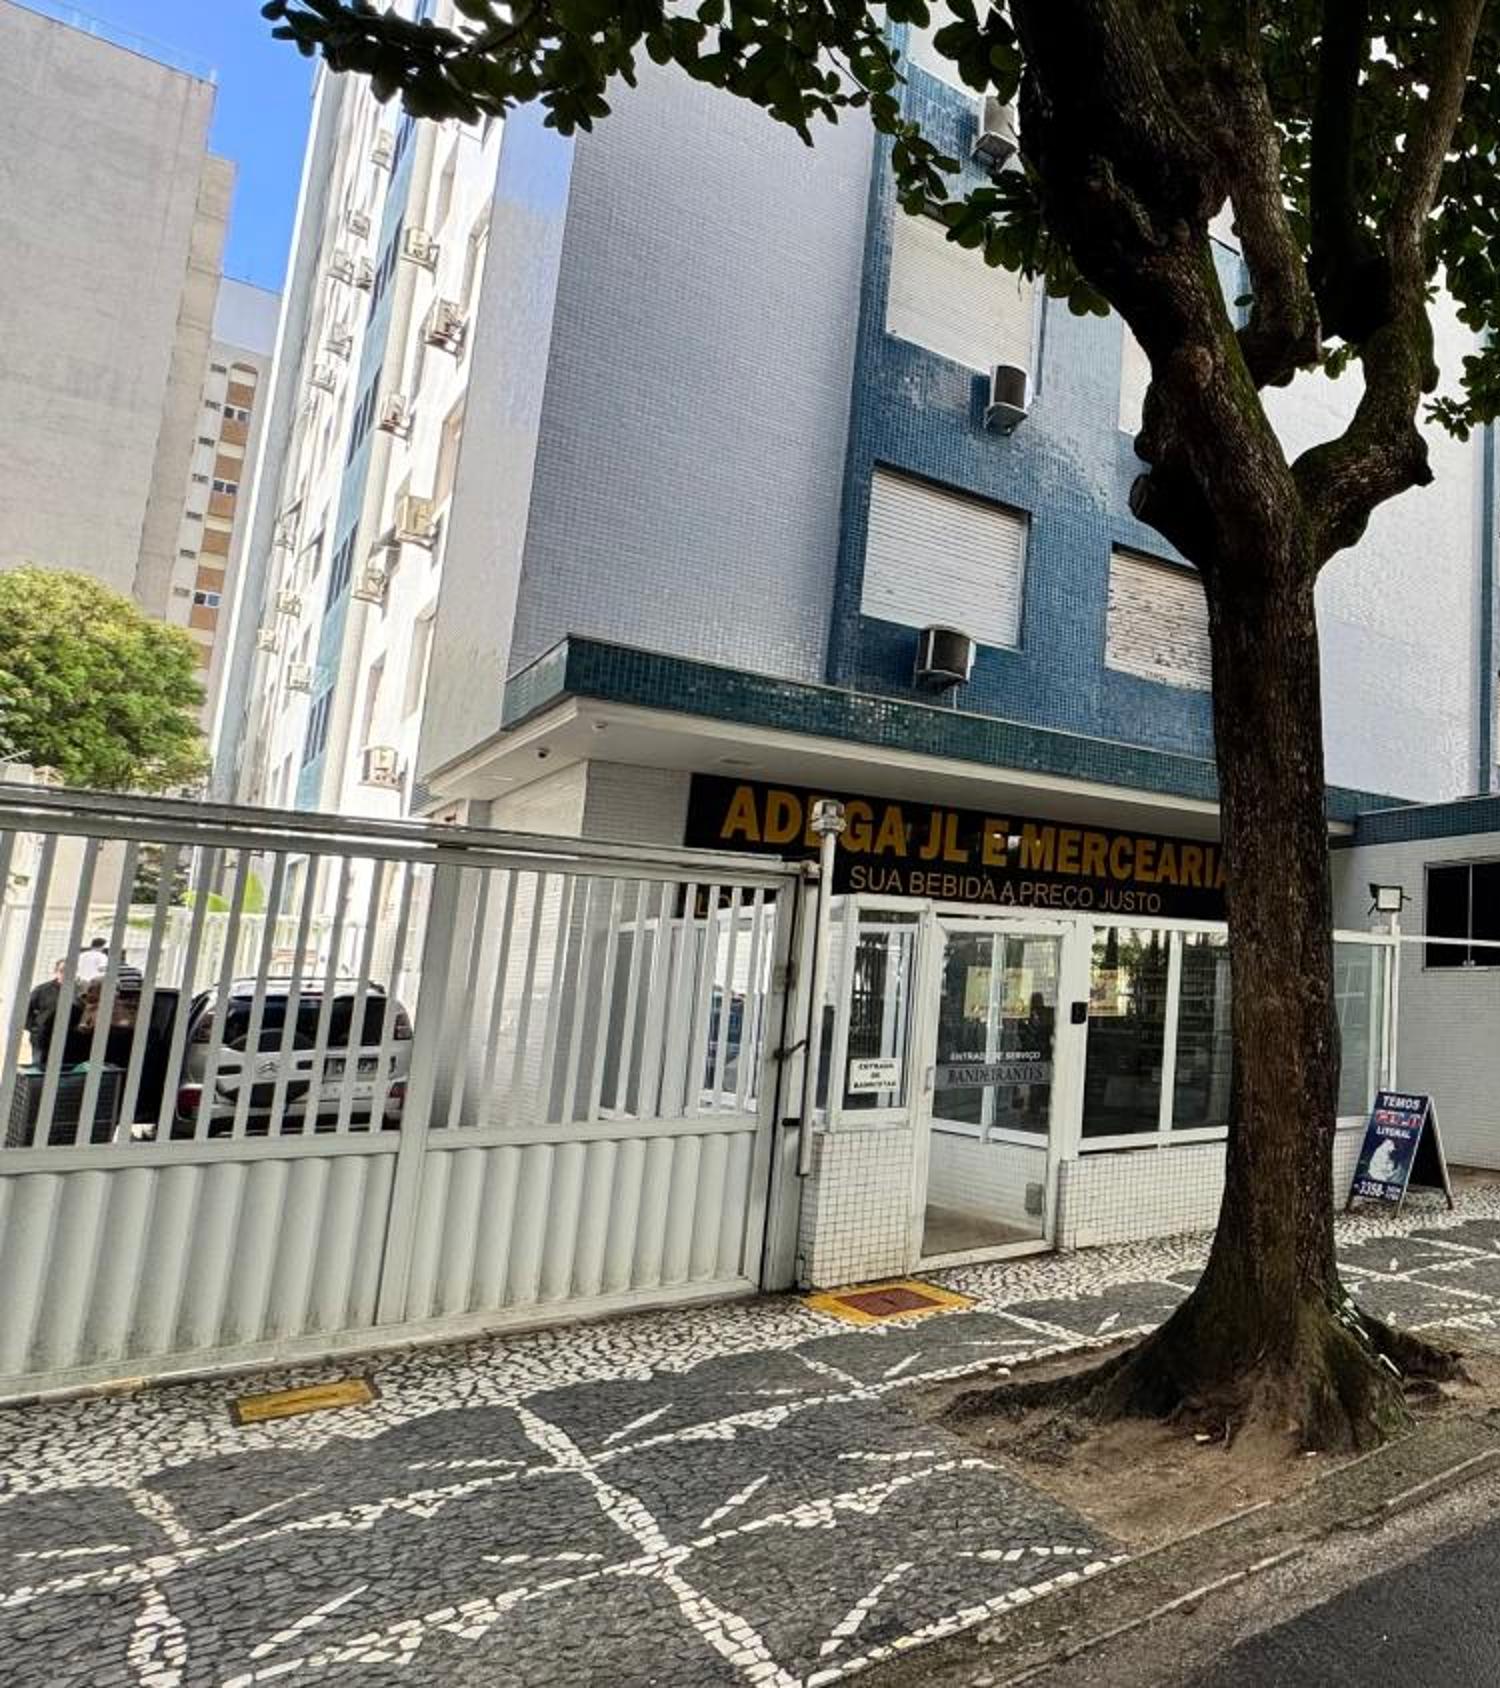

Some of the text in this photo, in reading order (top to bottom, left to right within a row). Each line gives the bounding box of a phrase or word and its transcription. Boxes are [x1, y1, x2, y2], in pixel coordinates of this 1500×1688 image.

[920, 810, 968, 863] JL
[981, 818, 1010, 867] E
[849, 865, 1161, 913] SUA BEBIDA A PREÇO JUSTO
[1383, 1096, 1420, 1110] TEMOS
[1376, 1125, 1411, 1139] LITORAL
